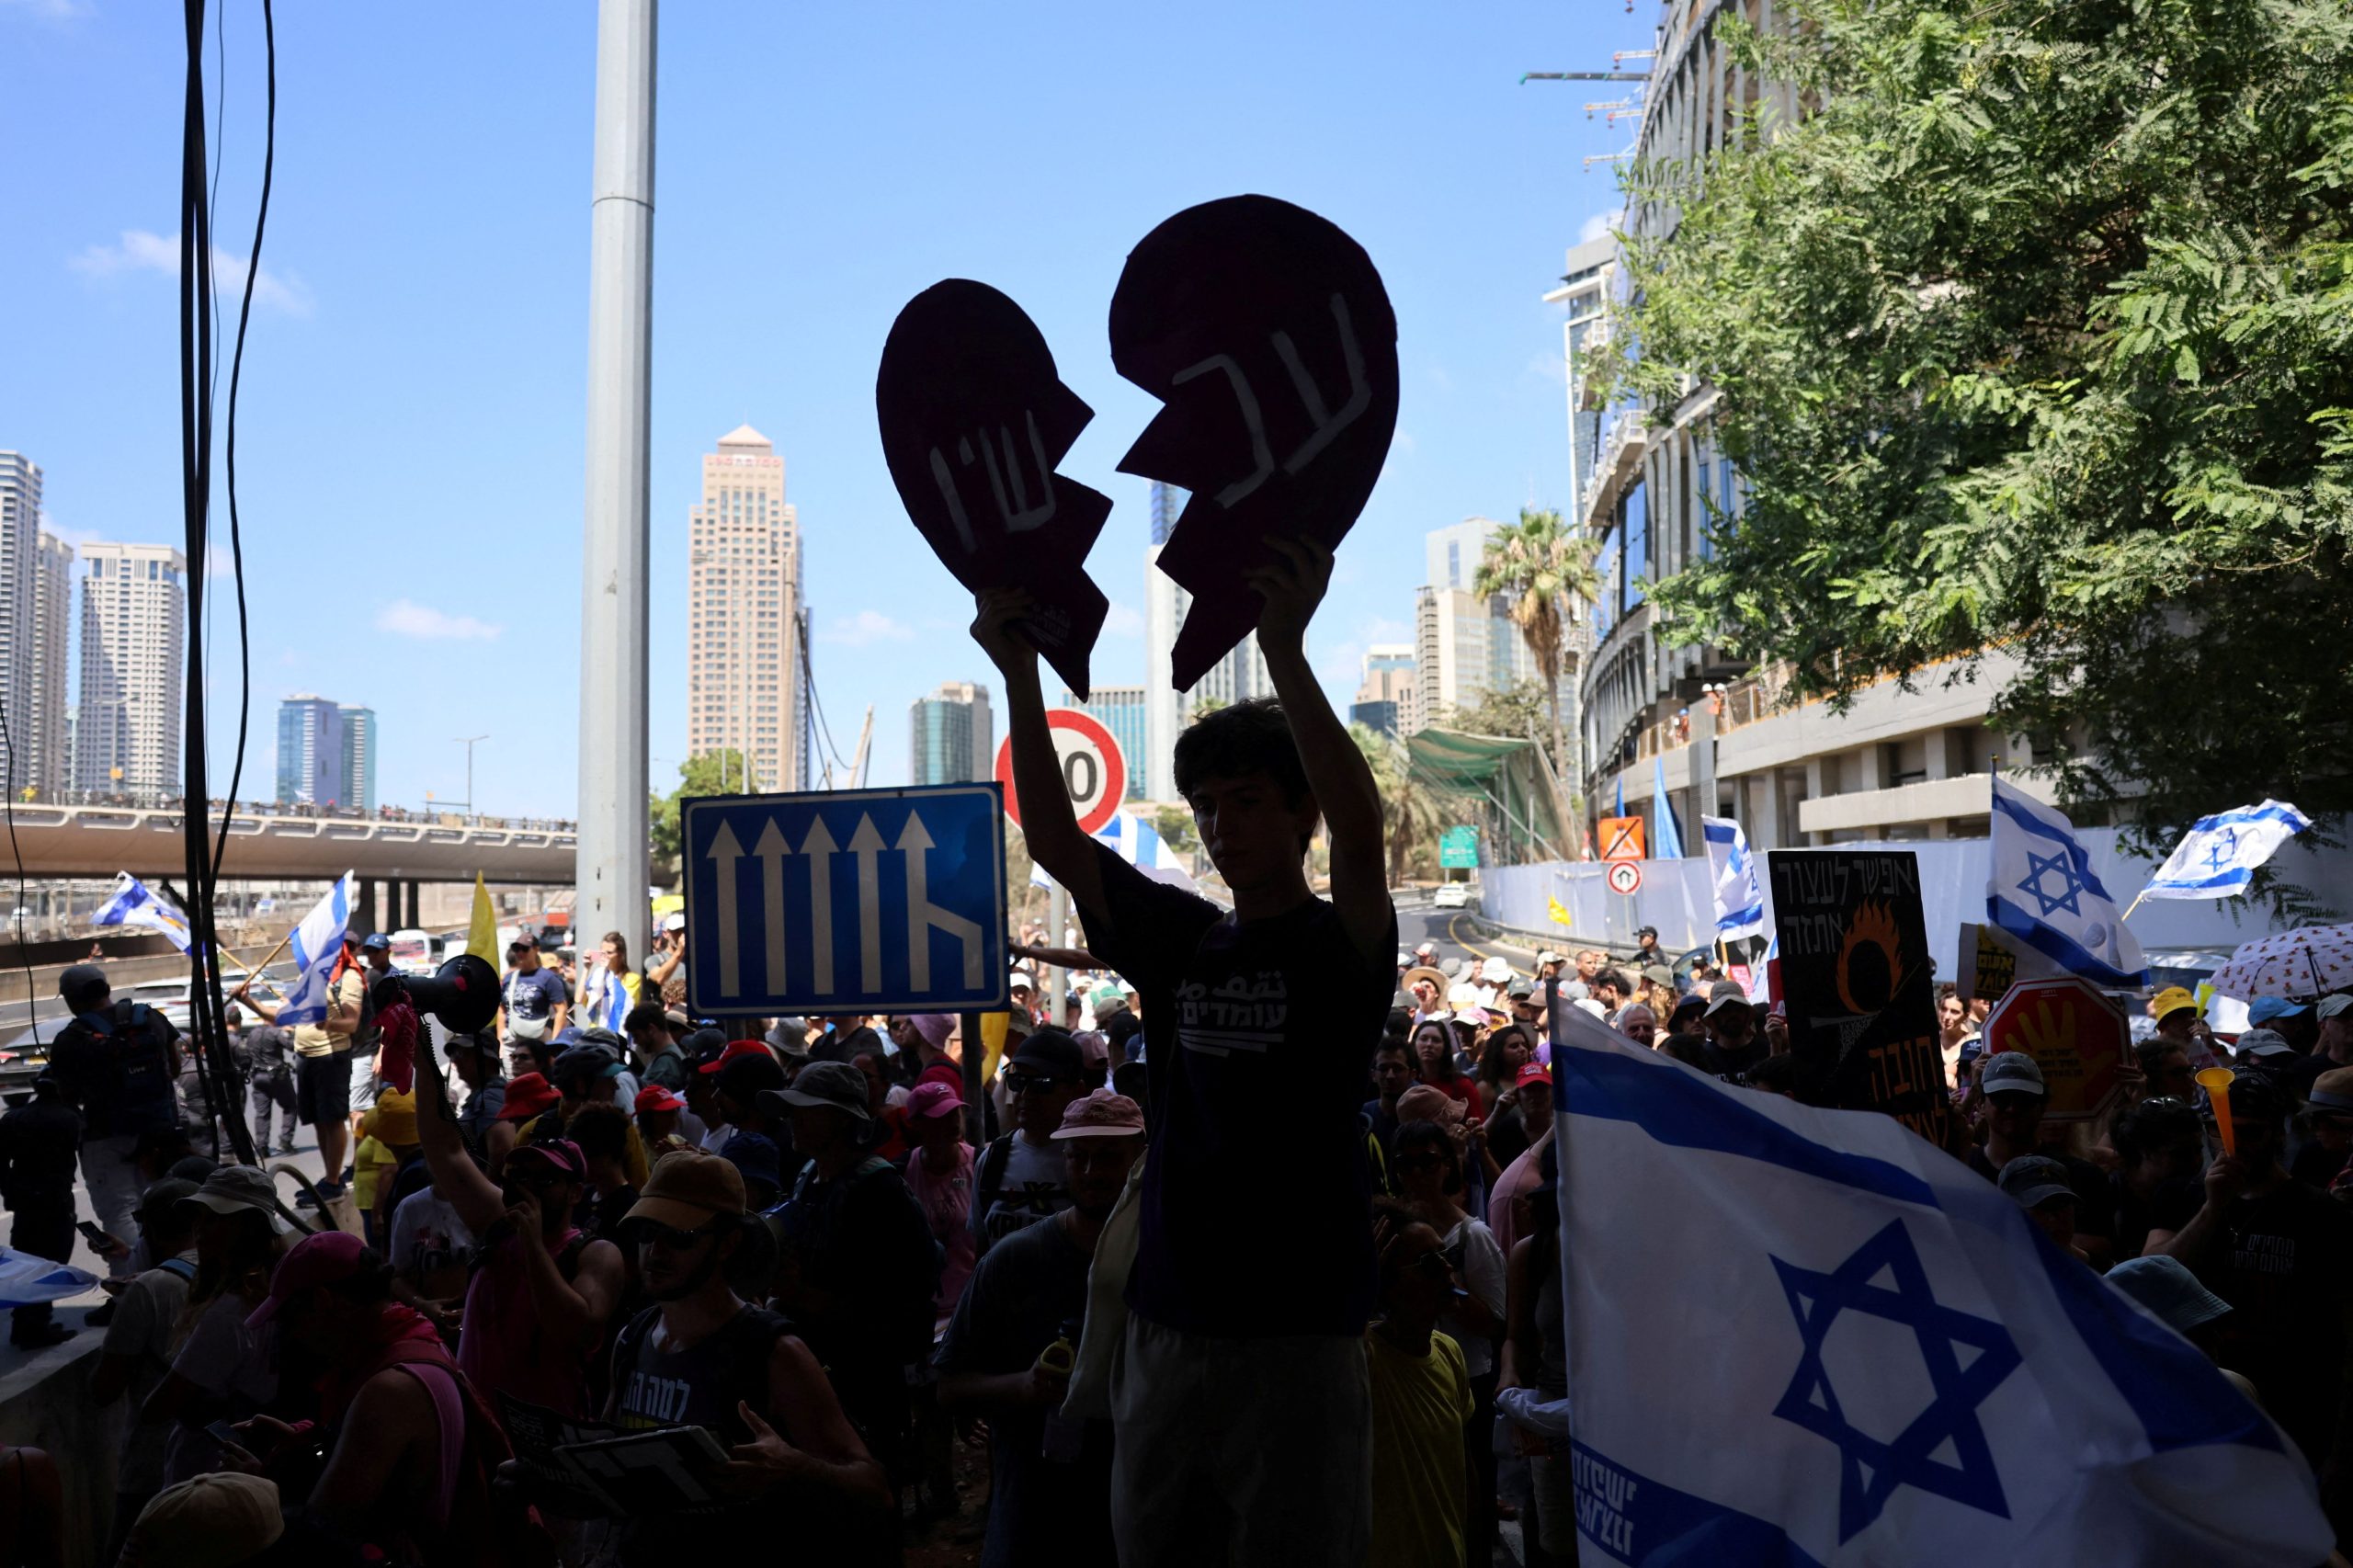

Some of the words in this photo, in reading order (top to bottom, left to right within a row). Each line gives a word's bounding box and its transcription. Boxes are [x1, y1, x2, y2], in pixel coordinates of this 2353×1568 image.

[1853, 857, 1916, 896] אפשר
[1182, 1001, 1289, 1029] עומדים
[1868, 1036, 1940, 1104] חובה
[646, 1375, 691, 1423] למה
